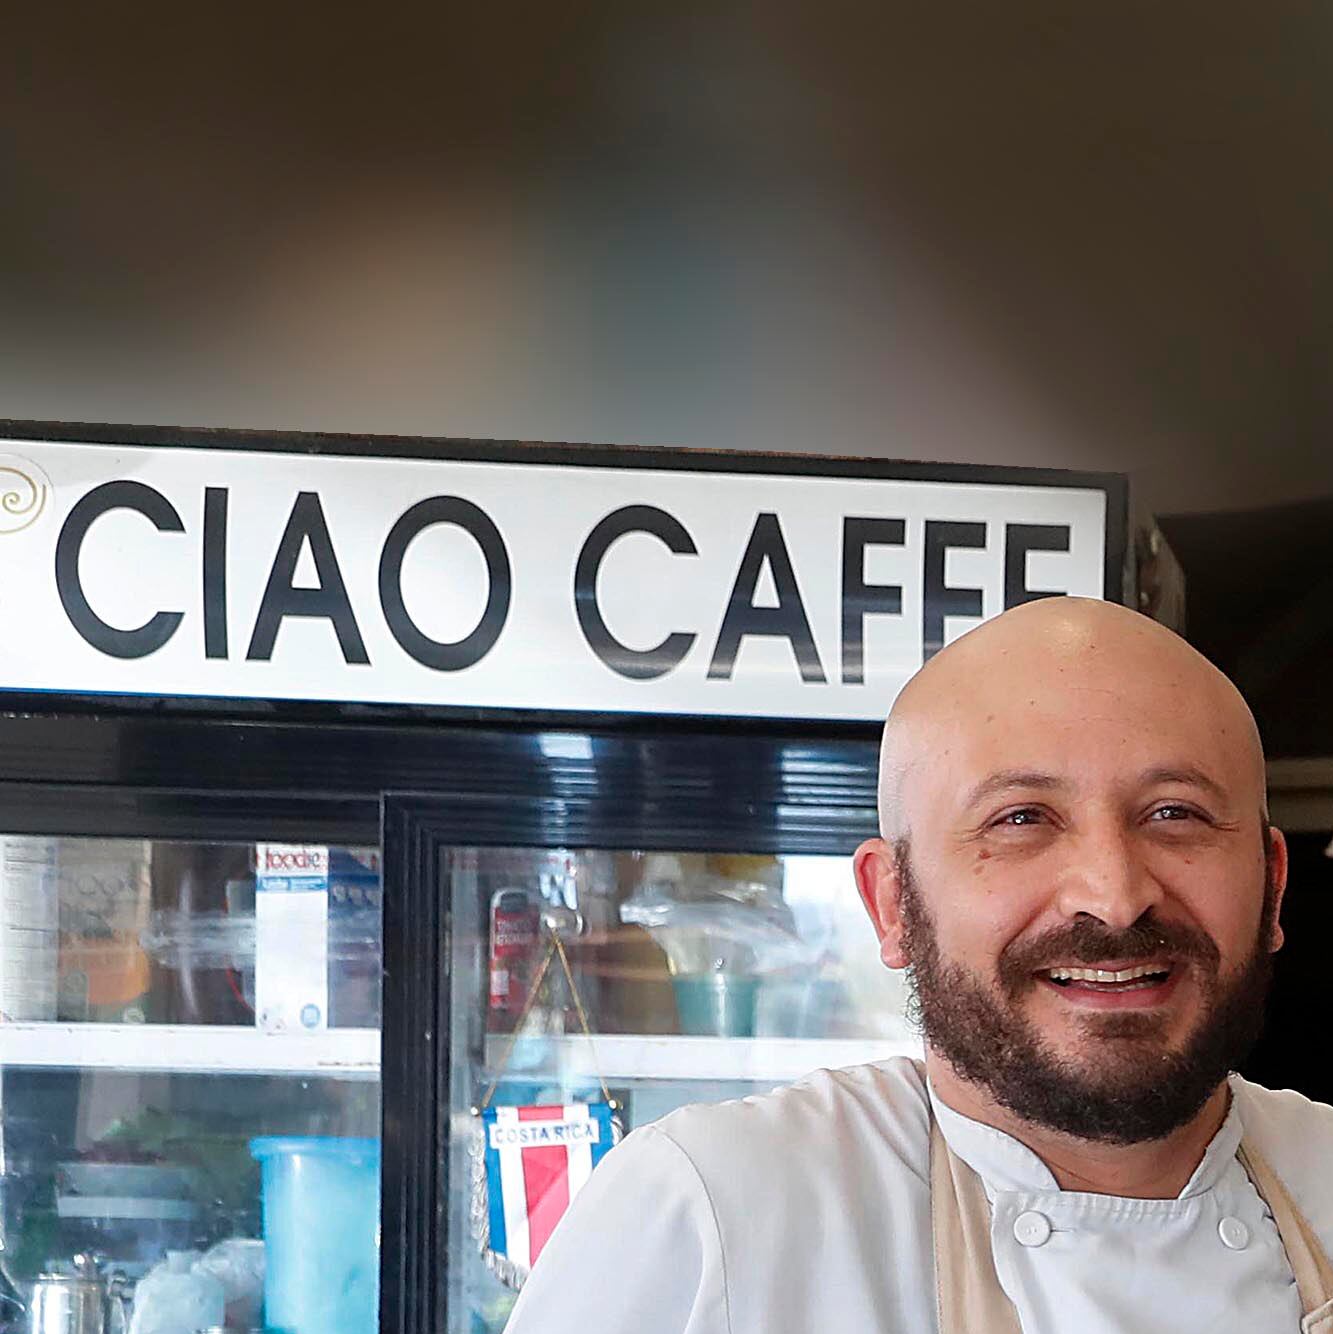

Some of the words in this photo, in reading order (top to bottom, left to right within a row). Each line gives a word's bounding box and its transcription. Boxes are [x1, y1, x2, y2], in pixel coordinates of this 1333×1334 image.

[55, 480, 513, 671] CIAO
[495, 1127, 550, 1143] COSTA
[554, 1124, 594, 1141] RICA
